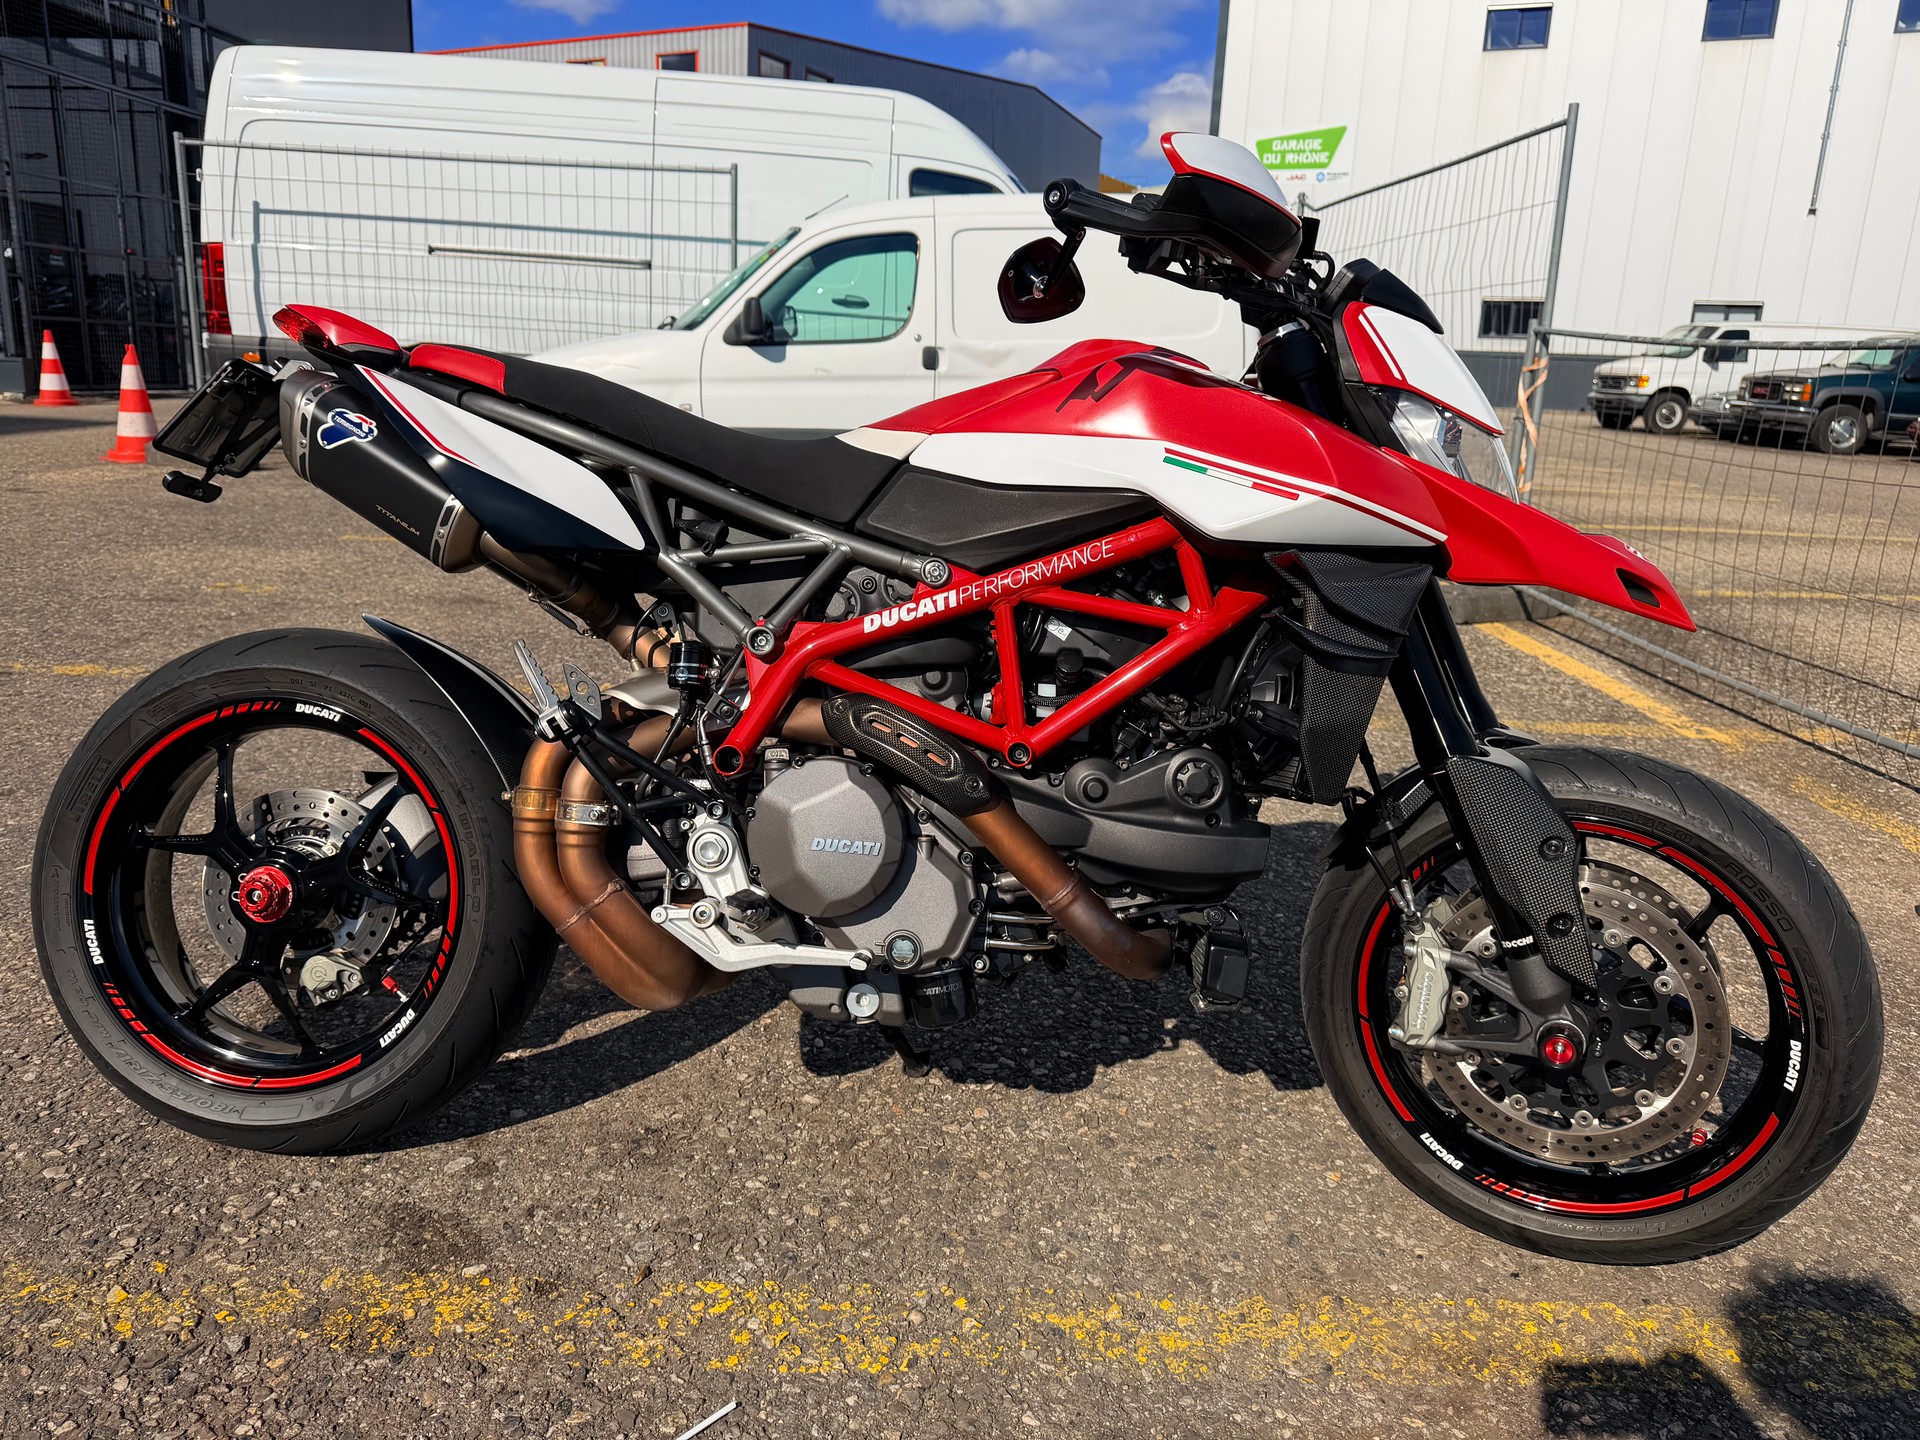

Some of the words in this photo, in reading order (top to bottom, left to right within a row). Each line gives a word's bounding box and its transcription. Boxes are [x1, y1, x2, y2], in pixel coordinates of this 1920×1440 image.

[1263, 153, 1281, 164] DU
[1285, 149, 1330, 163] RHÔNE
[1272, 139, 1323, 151] GARAGE
[334, 416, 366, 438] TERMIGNONI
[375, 504, 421, 536] TITANIUM
[863, 588, 958, 633] DUCATI
[959, 537, 1115, 605] PERFORMANCE
[295, 703, 341, 722] DUCATI
[769, 749, 785, 758] OIL
[459, 811, 481, 913] DIABLO
[811, 837, 882, 856] DUCATI
[1587, 802, 1694, 844] DIABLO
[1724, 861, 1794, 932] ROSSO
[84, 919, 104, 965] DUCATI
[1411, 972, 1433, 1029] brembo
[379, 1008, 416, 1048] DUCATI
[1783, 1040, 1802, 1092] DUCATI
[1419, 1132, 1464, 1171] DUCATI
